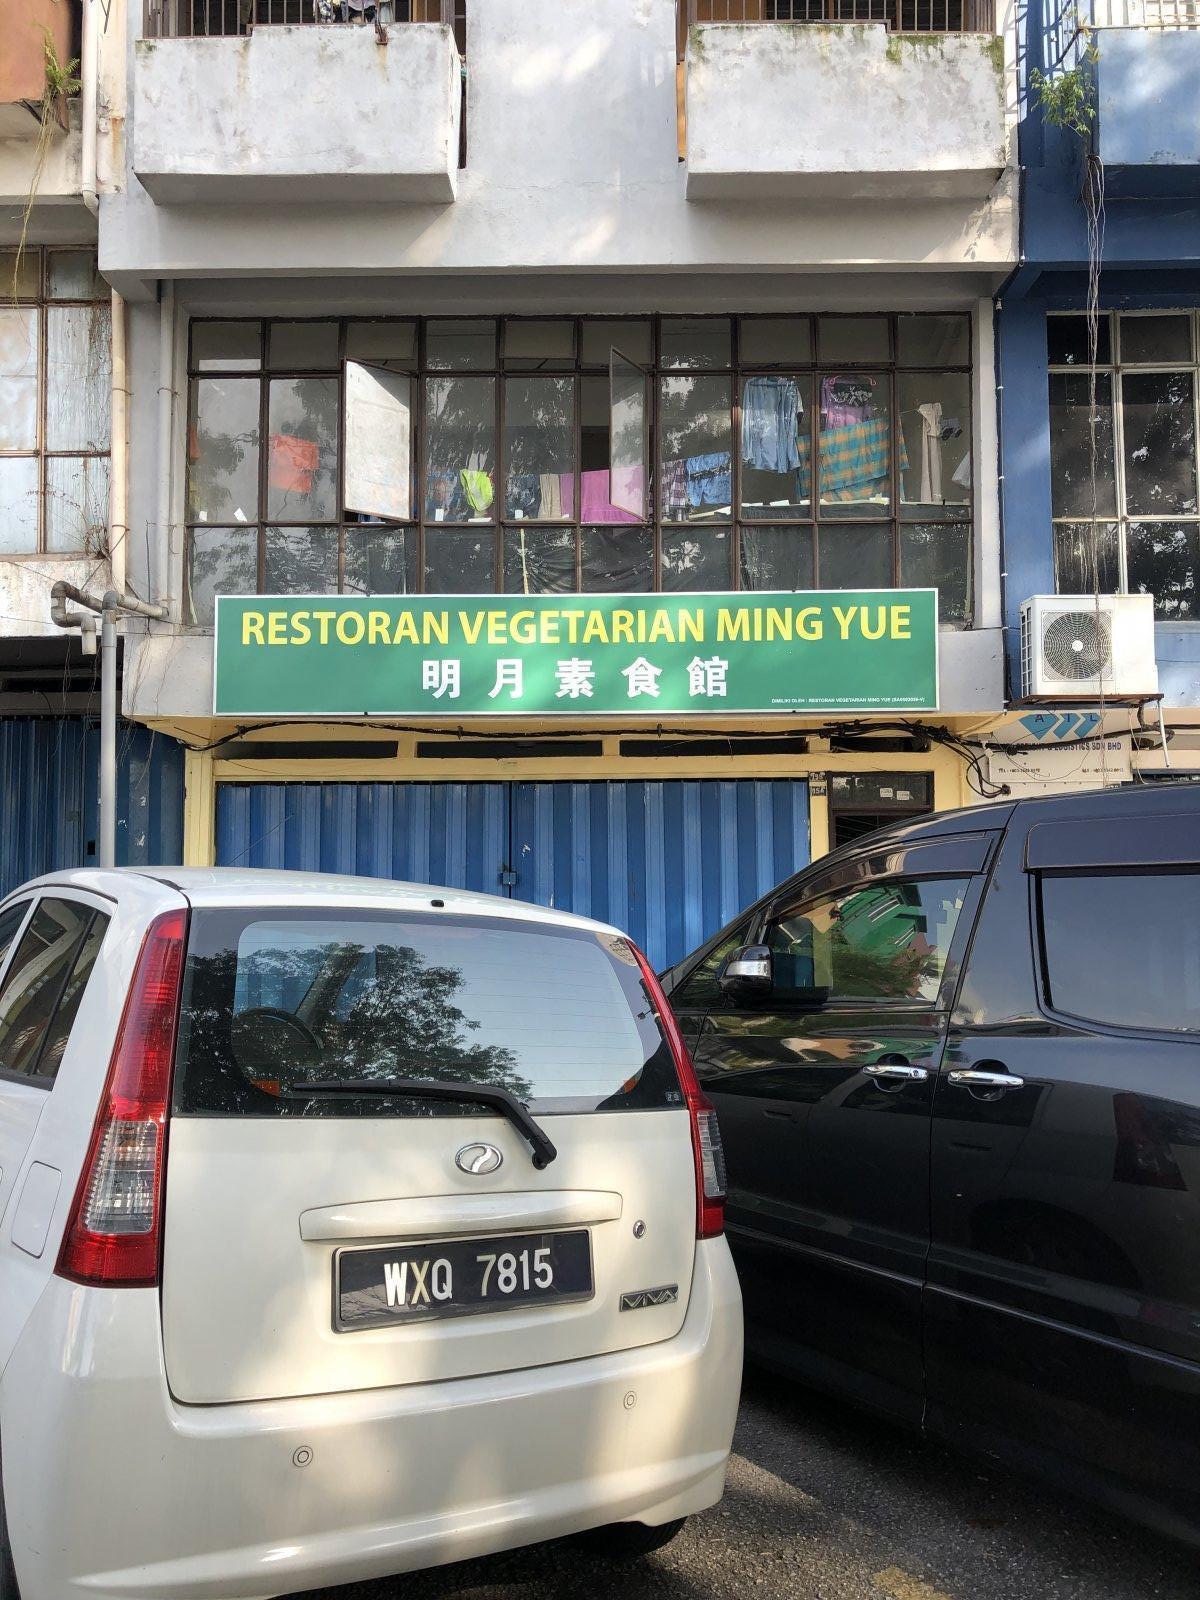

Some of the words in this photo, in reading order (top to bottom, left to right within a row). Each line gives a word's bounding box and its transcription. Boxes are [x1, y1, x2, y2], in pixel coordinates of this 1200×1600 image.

[241, 611, 449, 646] RESTORAN
[458, 608, 704, 645] VEGETARIAN
[716, 606, 823, 642] MING
[831, 605, 911, 640] YUE
[421, 655, 729, 700] 明月素食館
[1092, 742, 1105, 751] SDN
[1107, 742, 1122, 751] BHD
[383, 1258, 453, 1307] WXQ
[476, 1248, 554, 1296] 7815
[621, 1287, 678, 1312] VIVA
